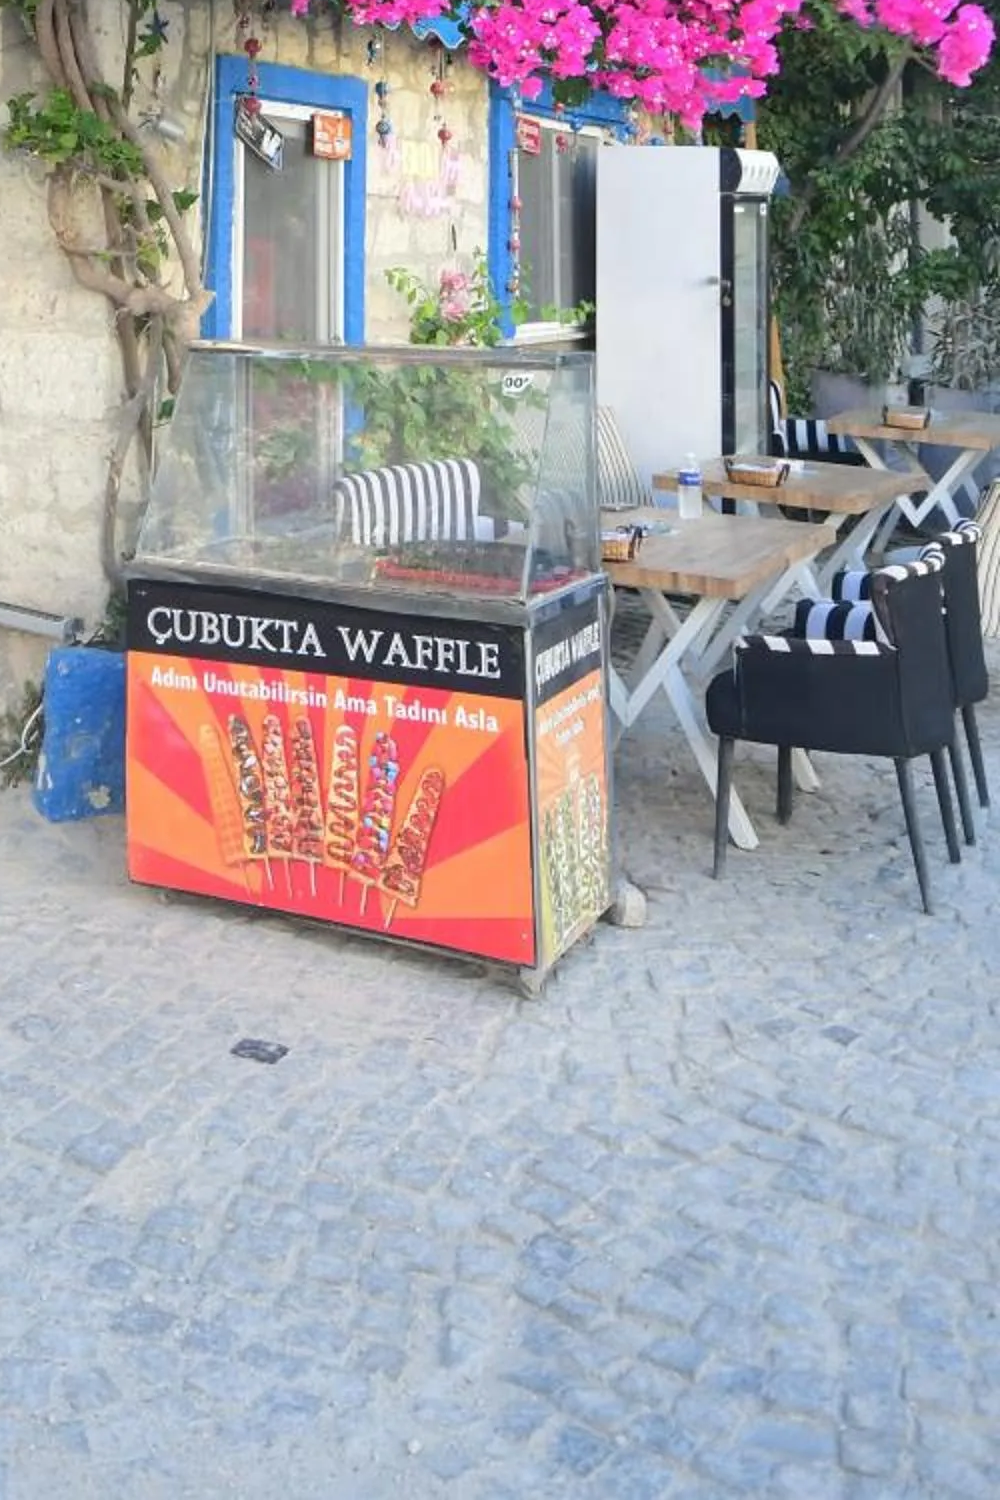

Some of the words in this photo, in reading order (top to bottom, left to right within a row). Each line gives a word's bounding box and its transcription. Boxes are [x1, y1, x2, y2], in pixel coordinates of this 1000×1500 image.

[147, 606, 328, 658] ÇUBUKTA
[337, 625, 501, 679] WAFFLE
[203, 671, 328, 709] Unutabilirsin
[334, 687, 377, 716] Ama
[454, 705, 498, 733] Asla
